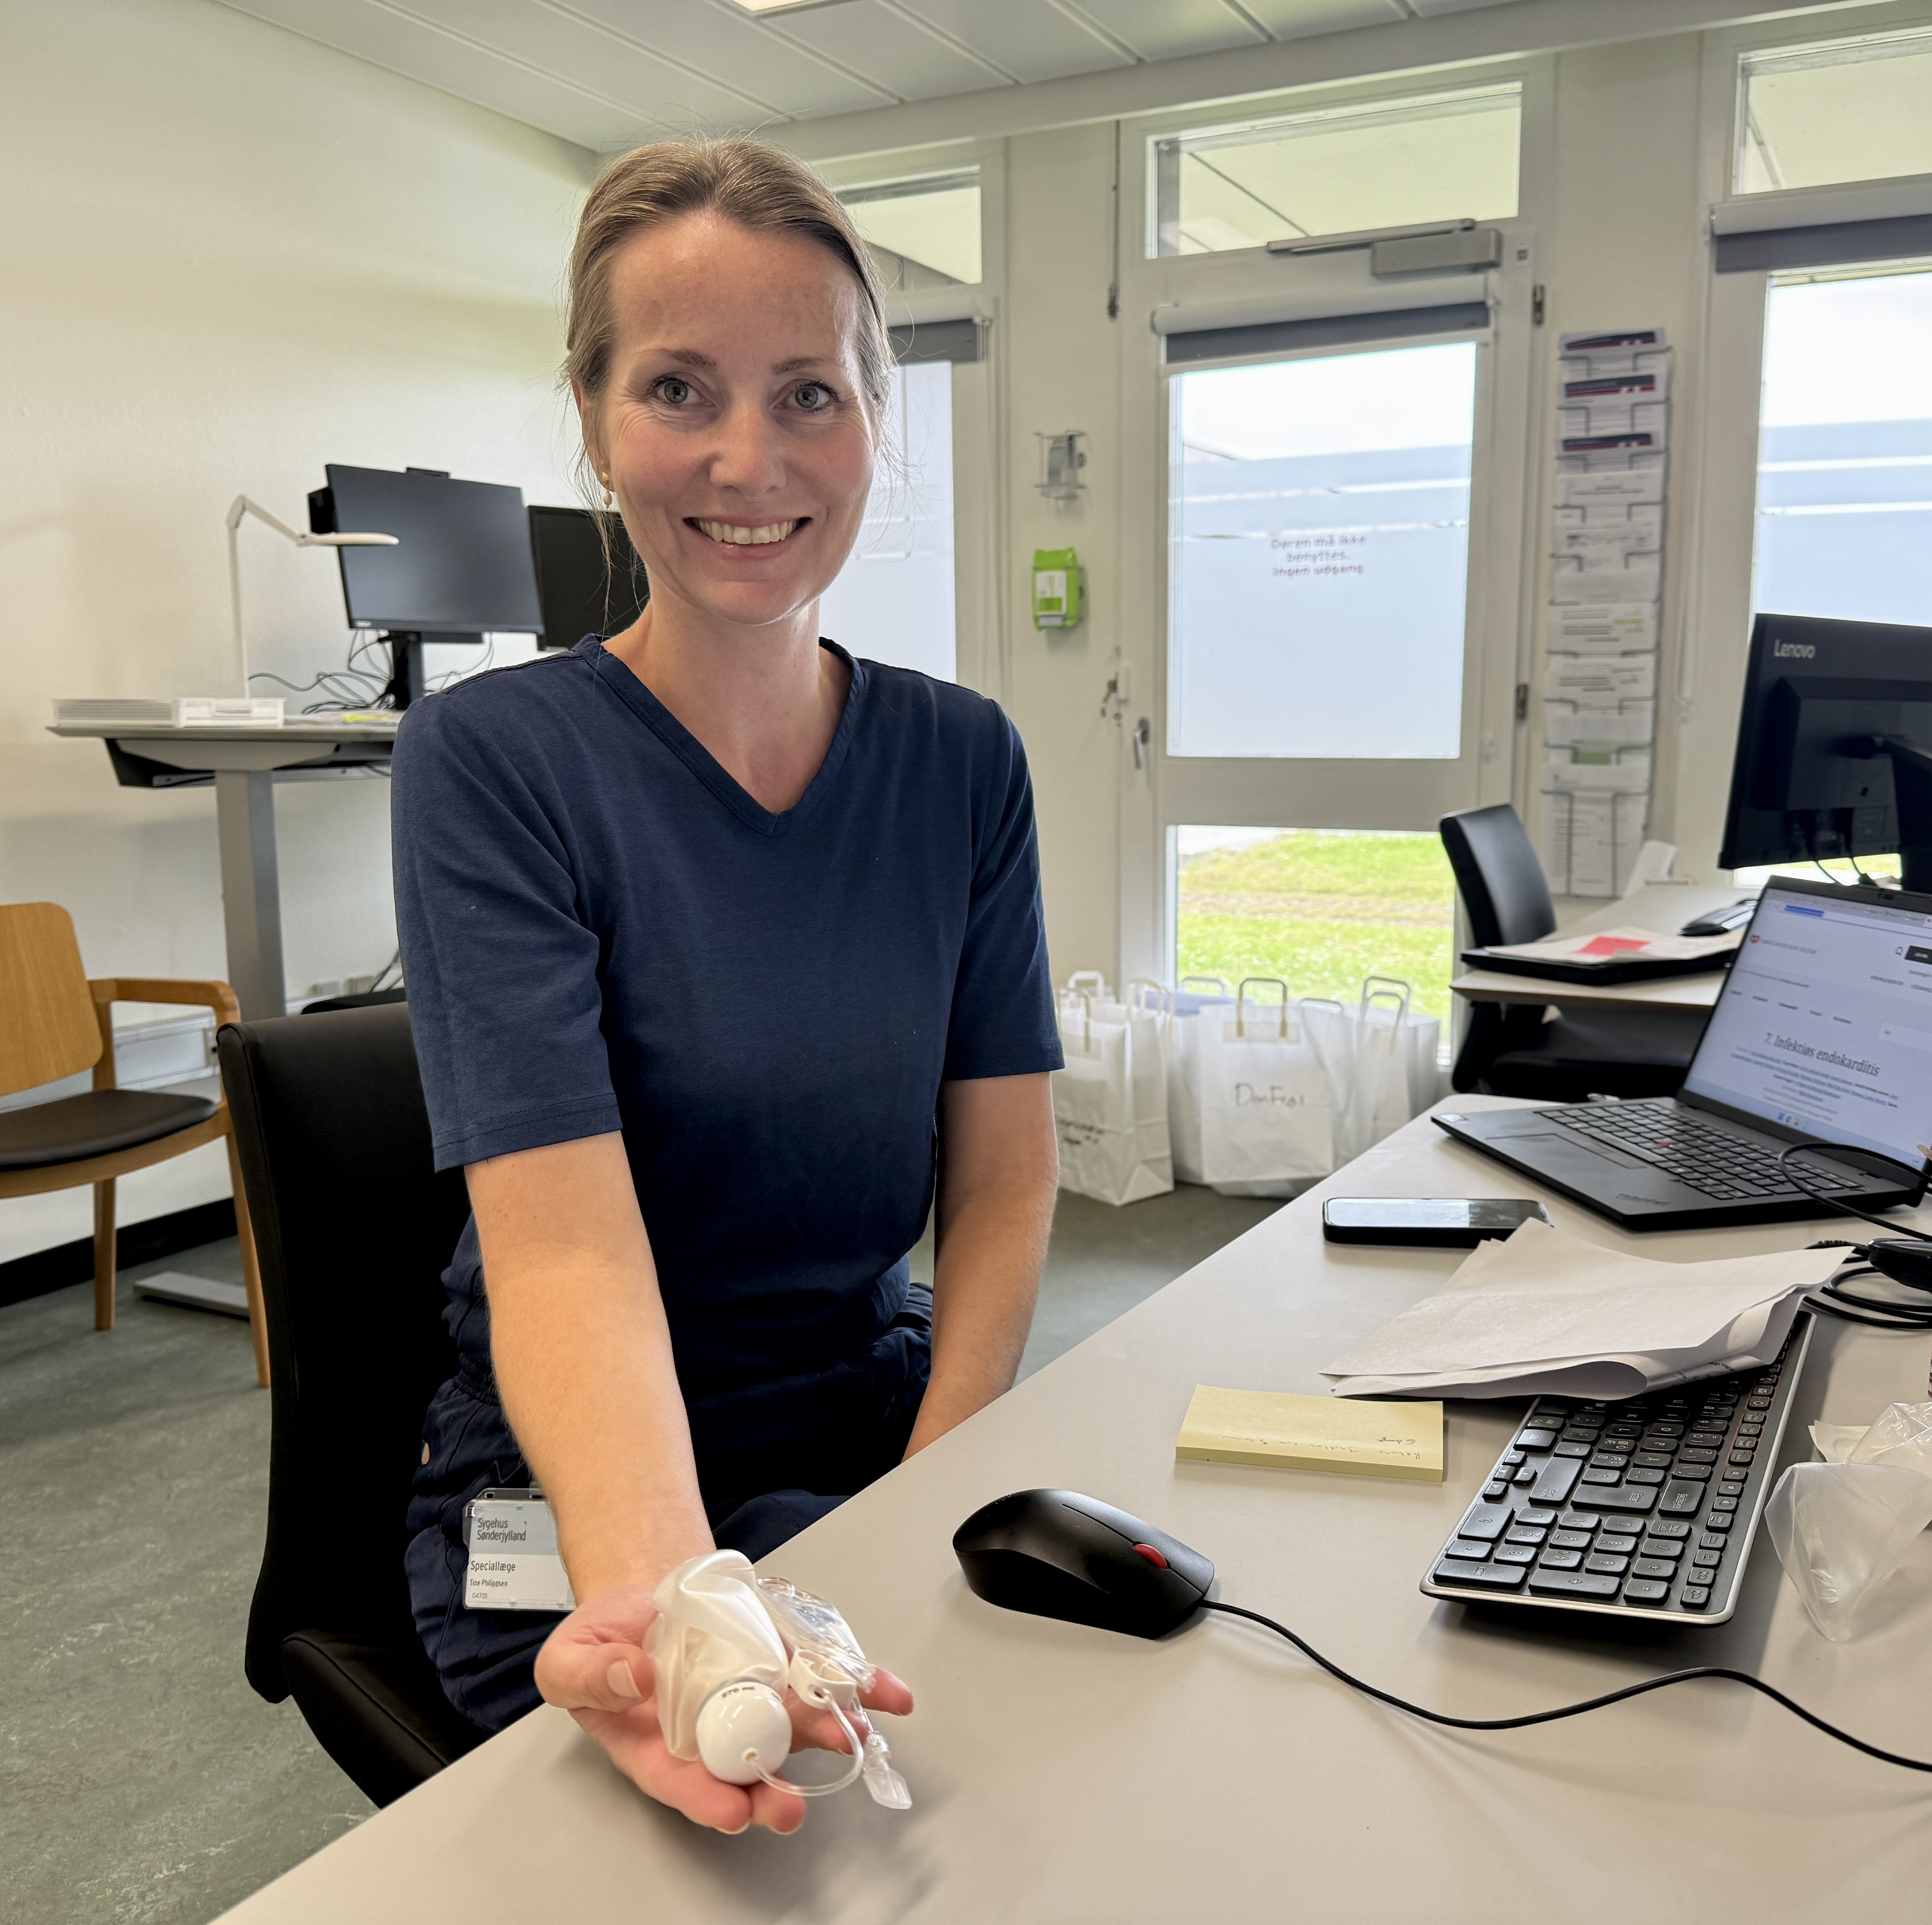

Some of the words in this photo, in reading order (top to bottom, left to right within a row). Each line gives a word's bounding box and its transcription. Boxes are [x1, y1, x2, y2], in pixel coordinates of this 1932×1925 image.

[1774, 639, 1815, 659] Lenovo
[1773, 1035, 1816, 1058] Infektiøs
[1816, 1049, 1881, 1077] endokarditis
[477, 1517, 508, 1530] Sygehus
[477, 1530, 527, 1543] Sønderjylland
[470, 1560, 516, 1573] Speciallæge
[482, 1579, 508, 1588] Philippsen
